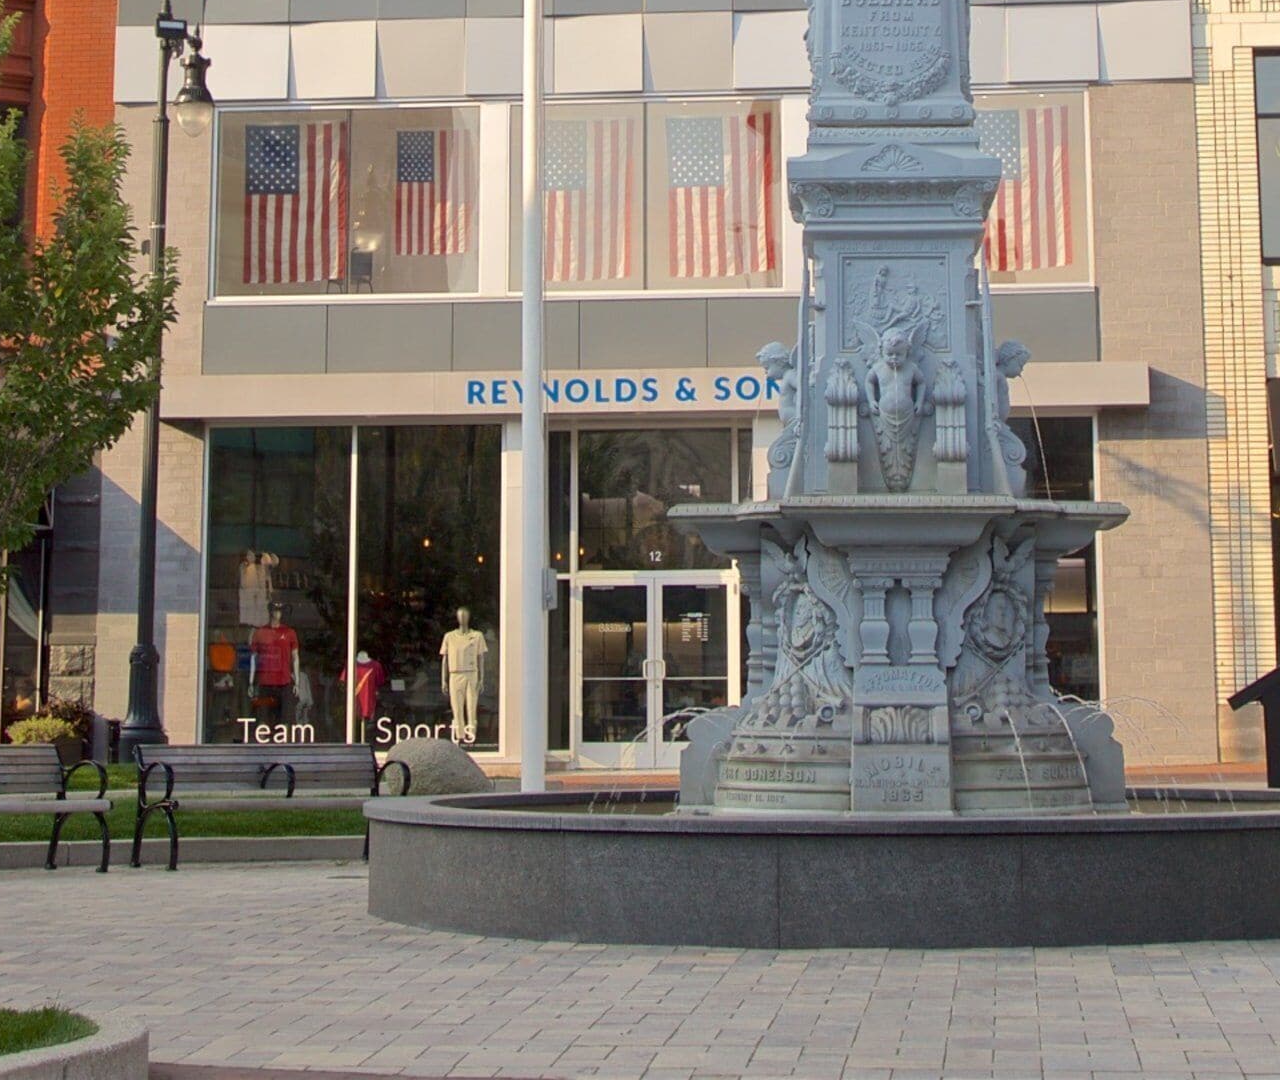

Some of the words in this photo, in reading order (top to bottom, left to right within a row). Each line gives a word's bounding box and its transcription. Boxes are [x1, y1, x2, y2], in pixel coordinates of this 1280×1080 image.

[869, 10, 914, 22] FROM
[675, 377, 697, 401] &
[650, 551, 661, 561] 12
[237, 718, 315, 743] Team
[376, 717, 476, 743] Sports
